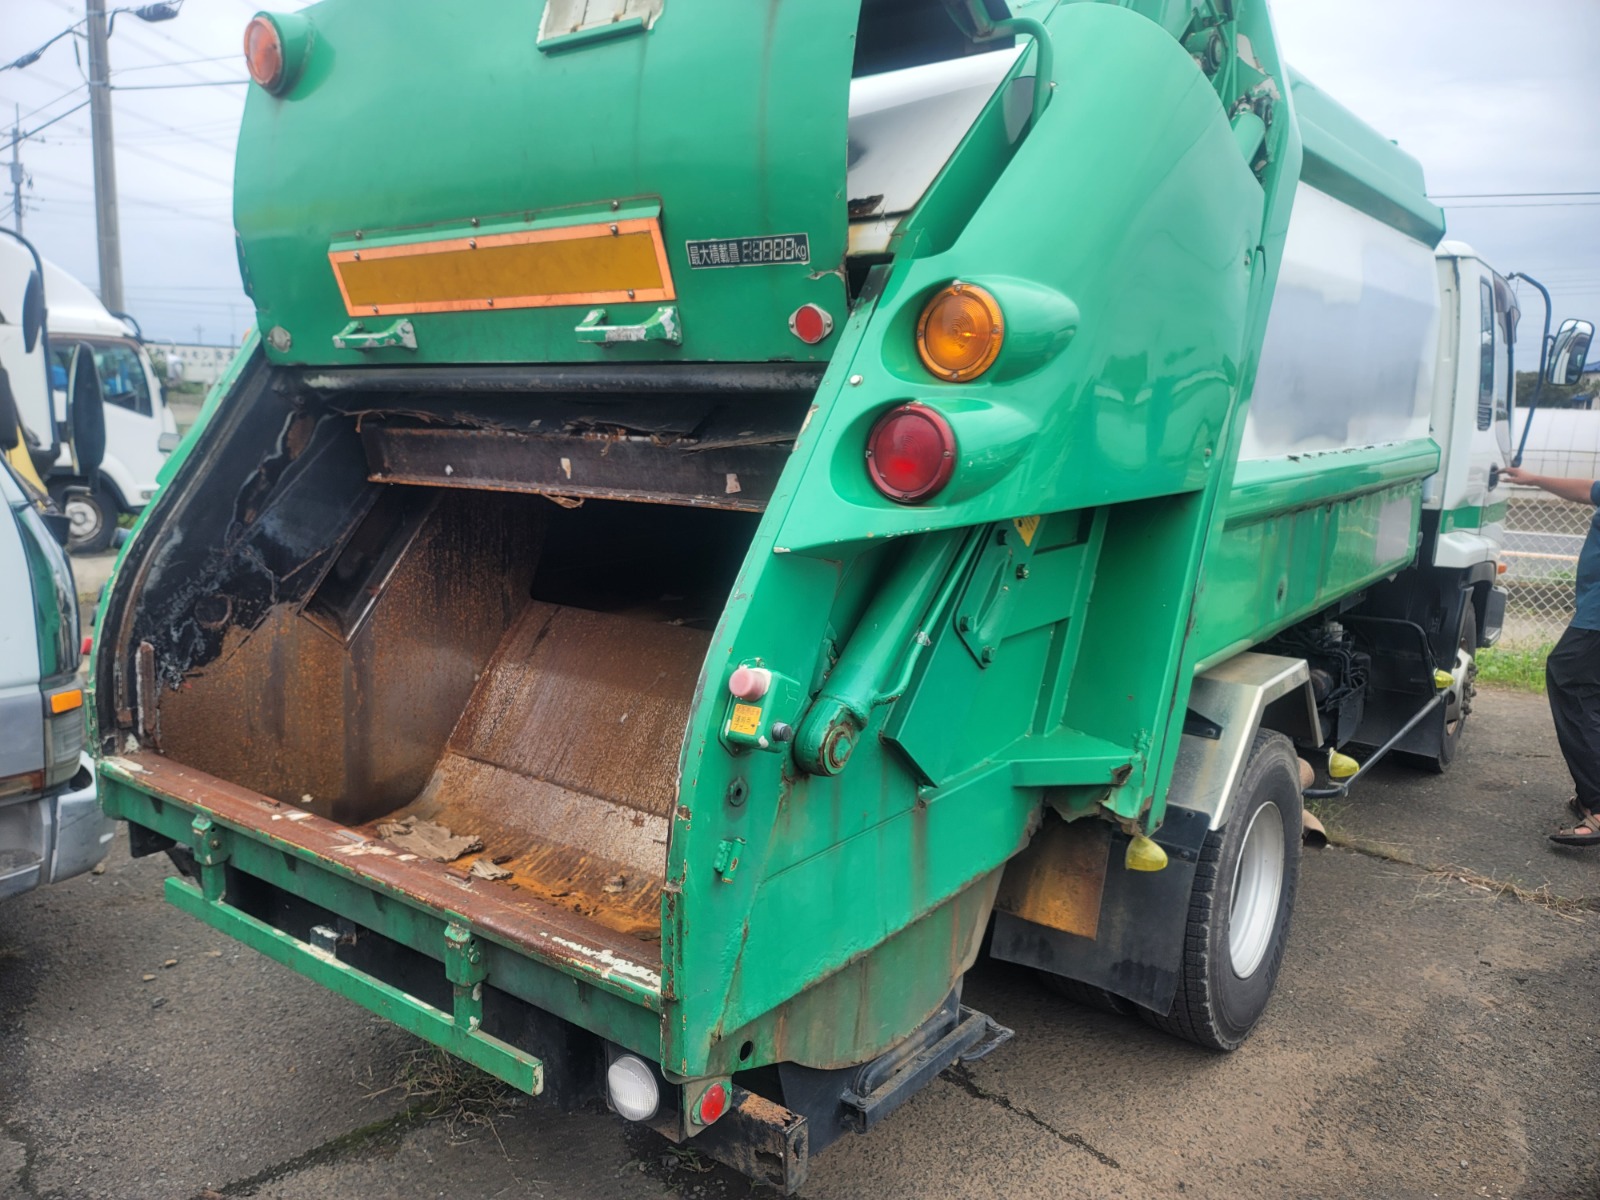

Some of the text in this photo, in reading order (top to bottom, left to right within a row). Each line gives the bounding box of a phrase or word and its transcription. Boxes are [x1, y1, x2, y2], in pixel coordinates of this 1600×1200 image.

[690, 243, 740, 265] 最大積載量
